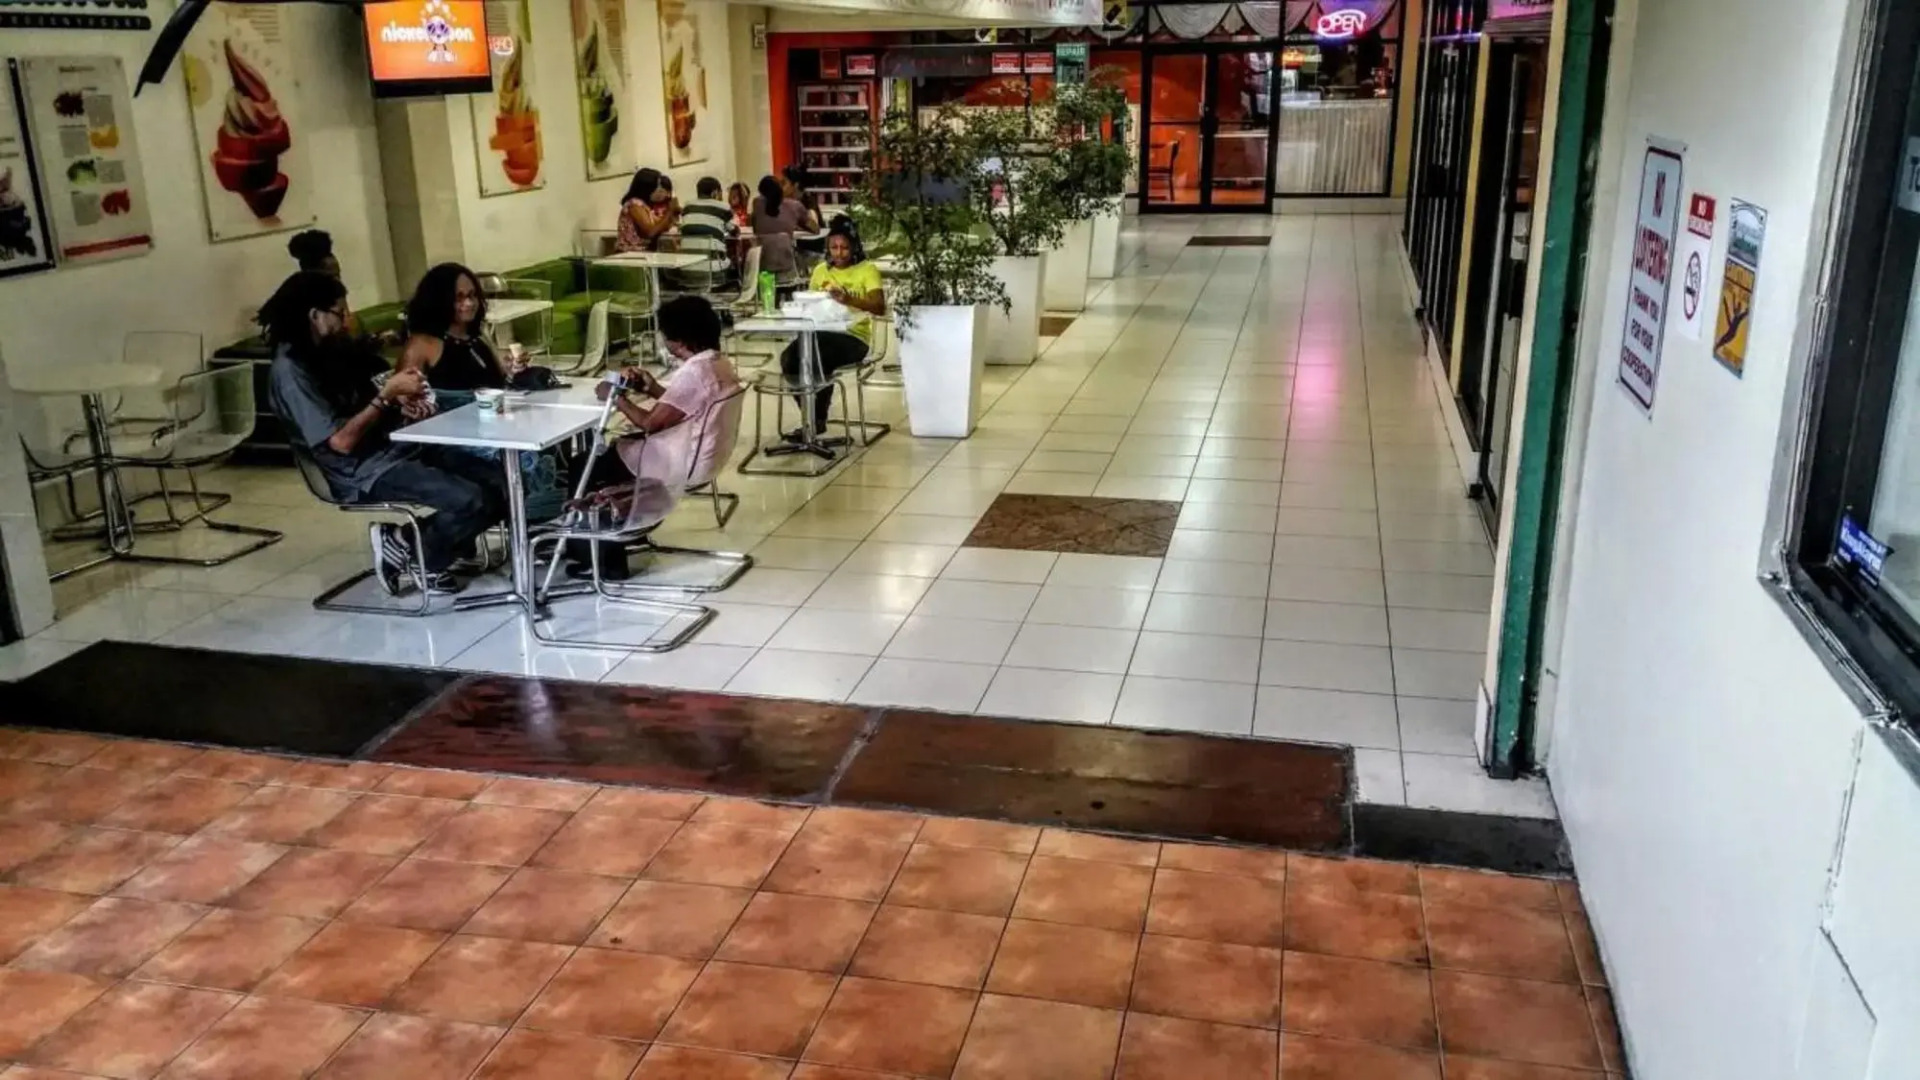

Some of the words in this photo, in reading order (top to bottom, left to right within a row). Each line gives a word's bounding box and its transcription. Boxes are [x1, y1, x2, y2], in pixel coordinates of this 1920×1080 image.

[381, 20, 475, 42] nickelon
[1318, 12, 1365, 35] OPEN
[1632, 285, 1650, 314] THANK
[1650, 299, 1660, 323] YOU
[1630, 317, 1641, 342] FOR
[1641, 327, 1654, 353] YOUR
[1622, 344, 1653, 389] COOPERATION
